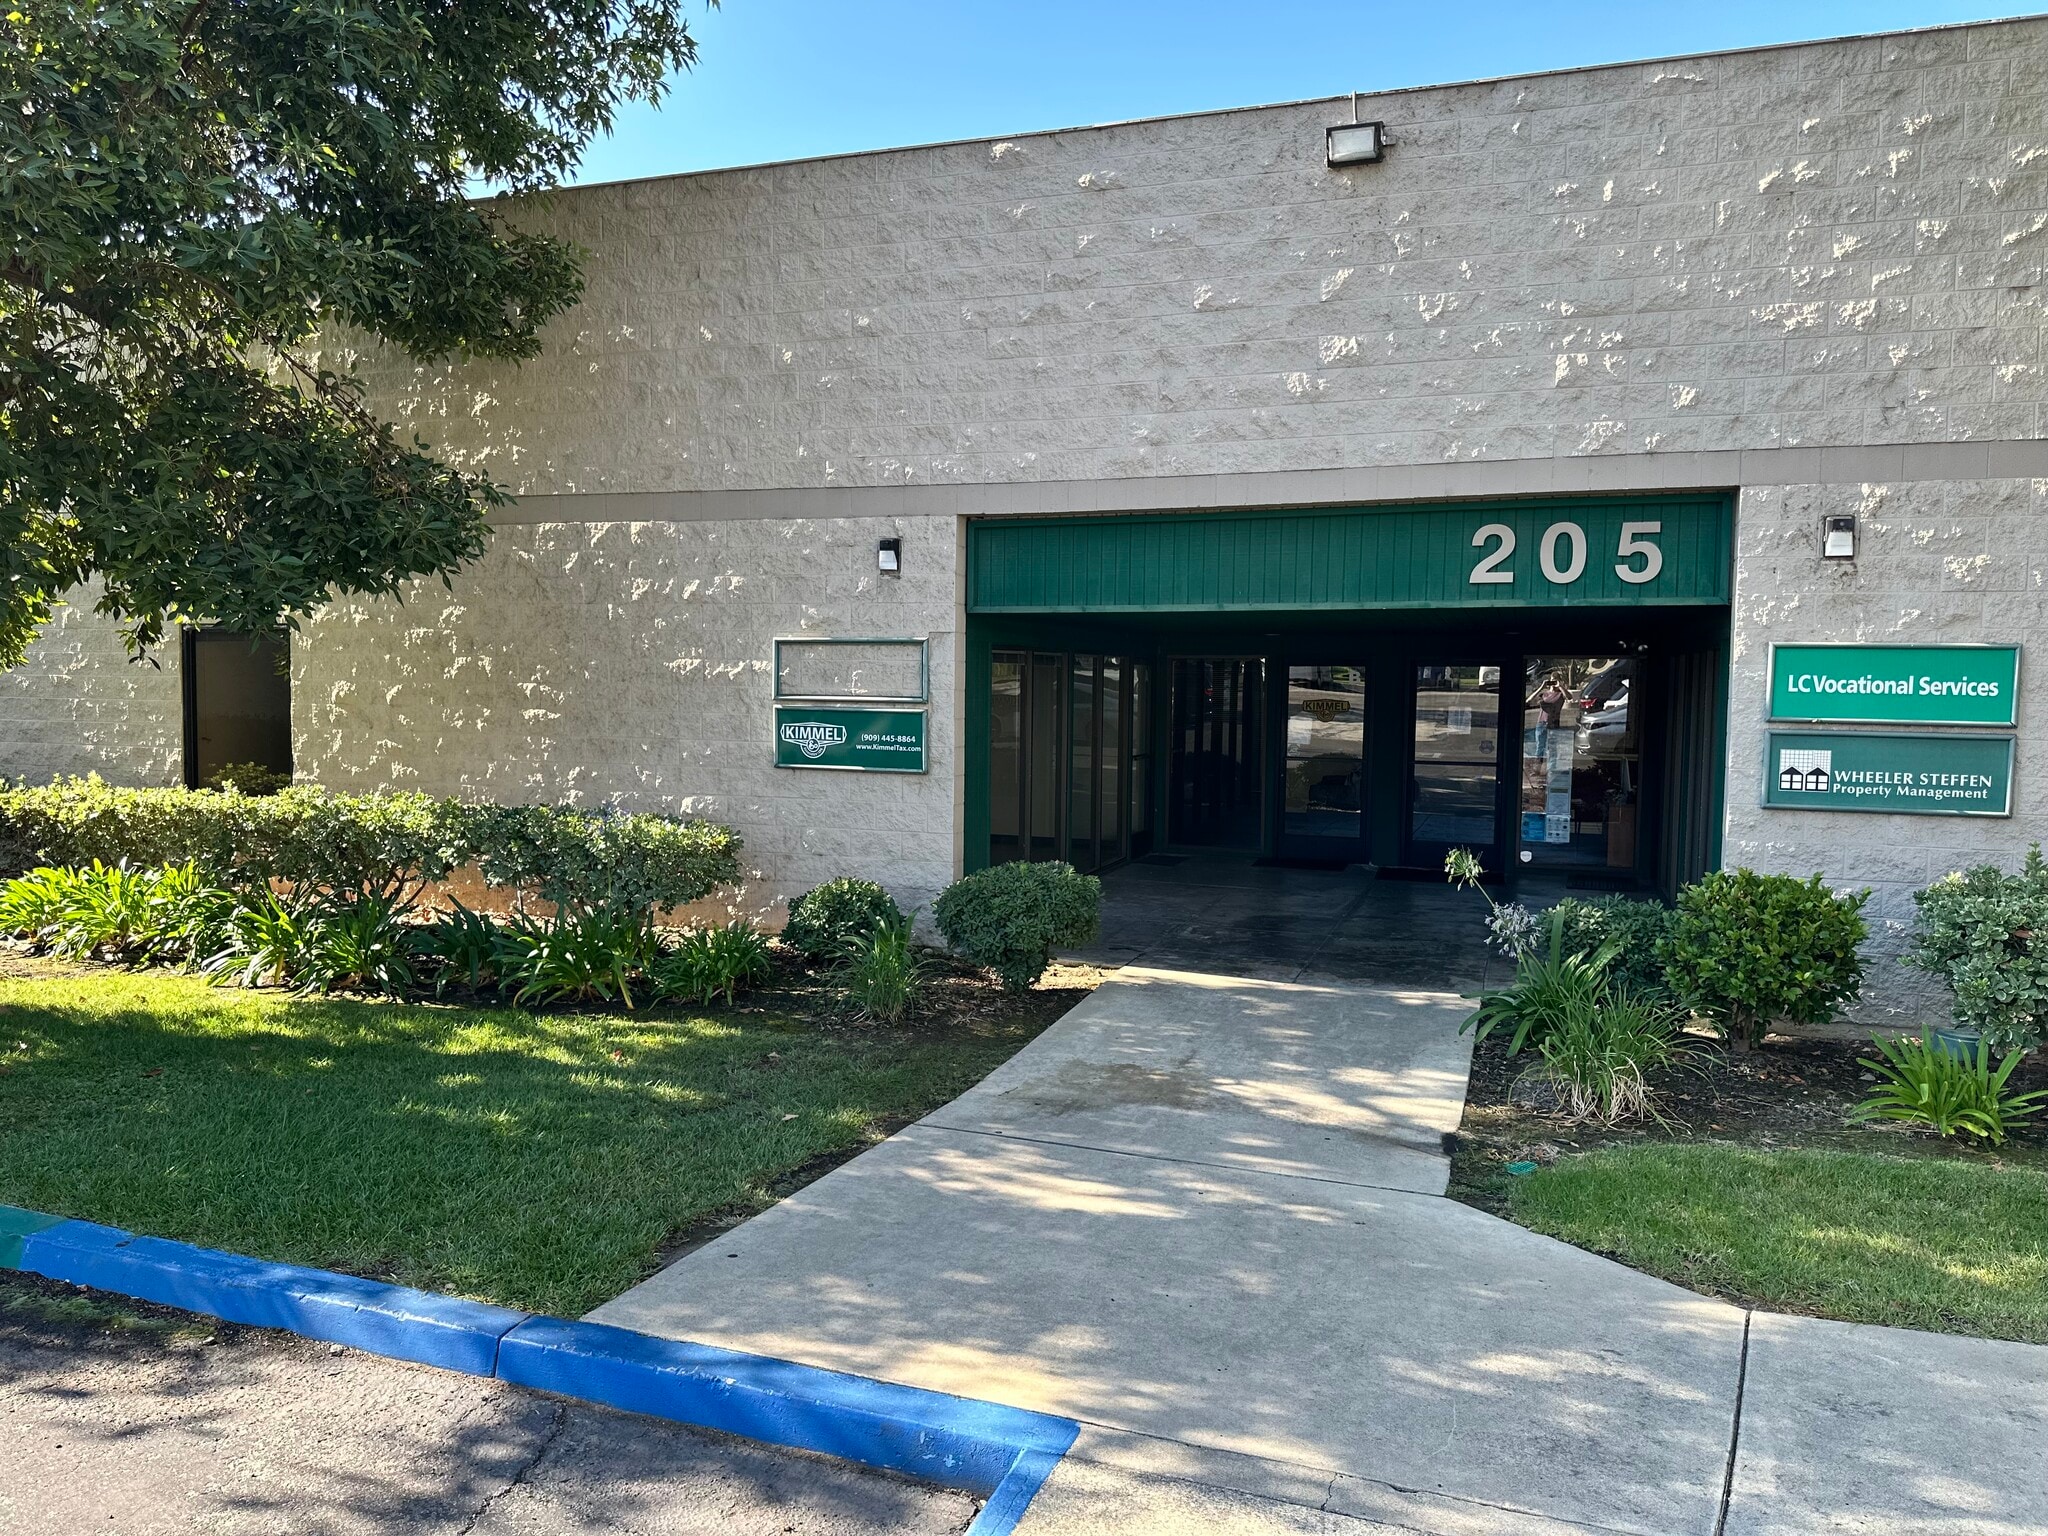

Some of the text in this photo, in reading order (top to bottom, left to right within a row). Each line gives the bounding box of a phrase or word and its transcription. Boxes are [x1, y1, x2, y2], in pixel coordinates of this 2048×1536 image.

[1469, 521, 1663, 583] 205
[1788, 674, 1999, 697] LC Vocational Services
[1305, 702, 1347, 711] KIMMEL
[785, 726, 842, 741] KIMMEL
[861, 733, 916, 743] (909) 445-8864
[856, 743, 922, 752] www.KimmelTax.com
[1834, 770, 1992, 788] WHEELER STEFFEN
[1833, 783, 1988, 801] Property Management
